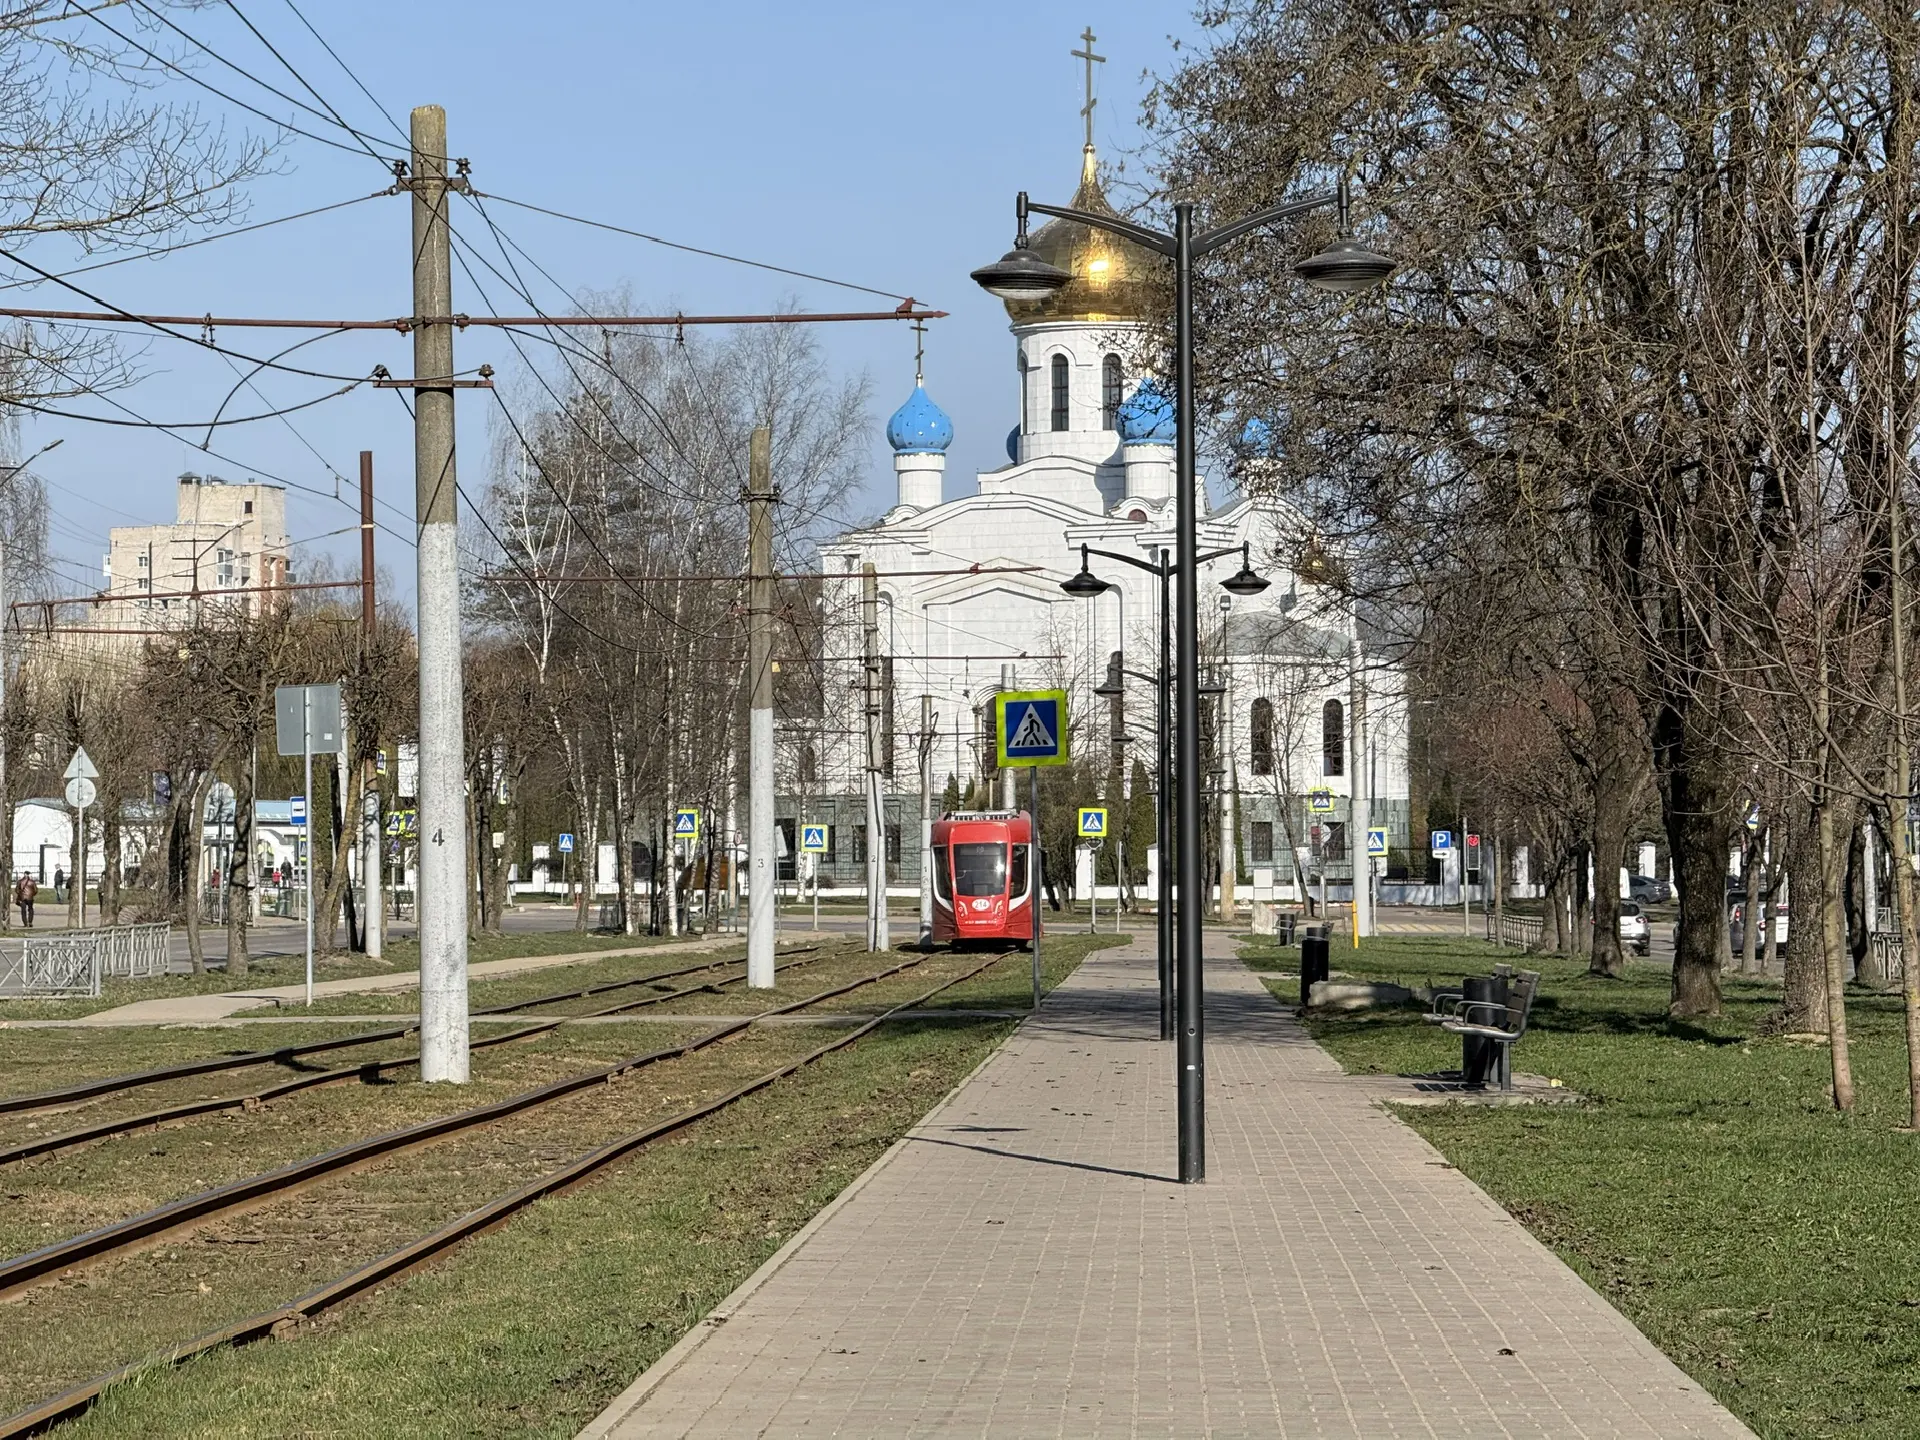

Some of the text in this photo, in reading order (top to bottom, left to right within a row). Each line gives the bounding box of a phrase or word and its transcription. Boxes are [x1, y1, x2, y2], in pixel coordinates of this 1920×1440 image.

[432, 828, 445, 847] 4
[1436, 833, 1446, 847] P
[757, 858, 764, 869] 3
[871, 855, 876, 863] 2
